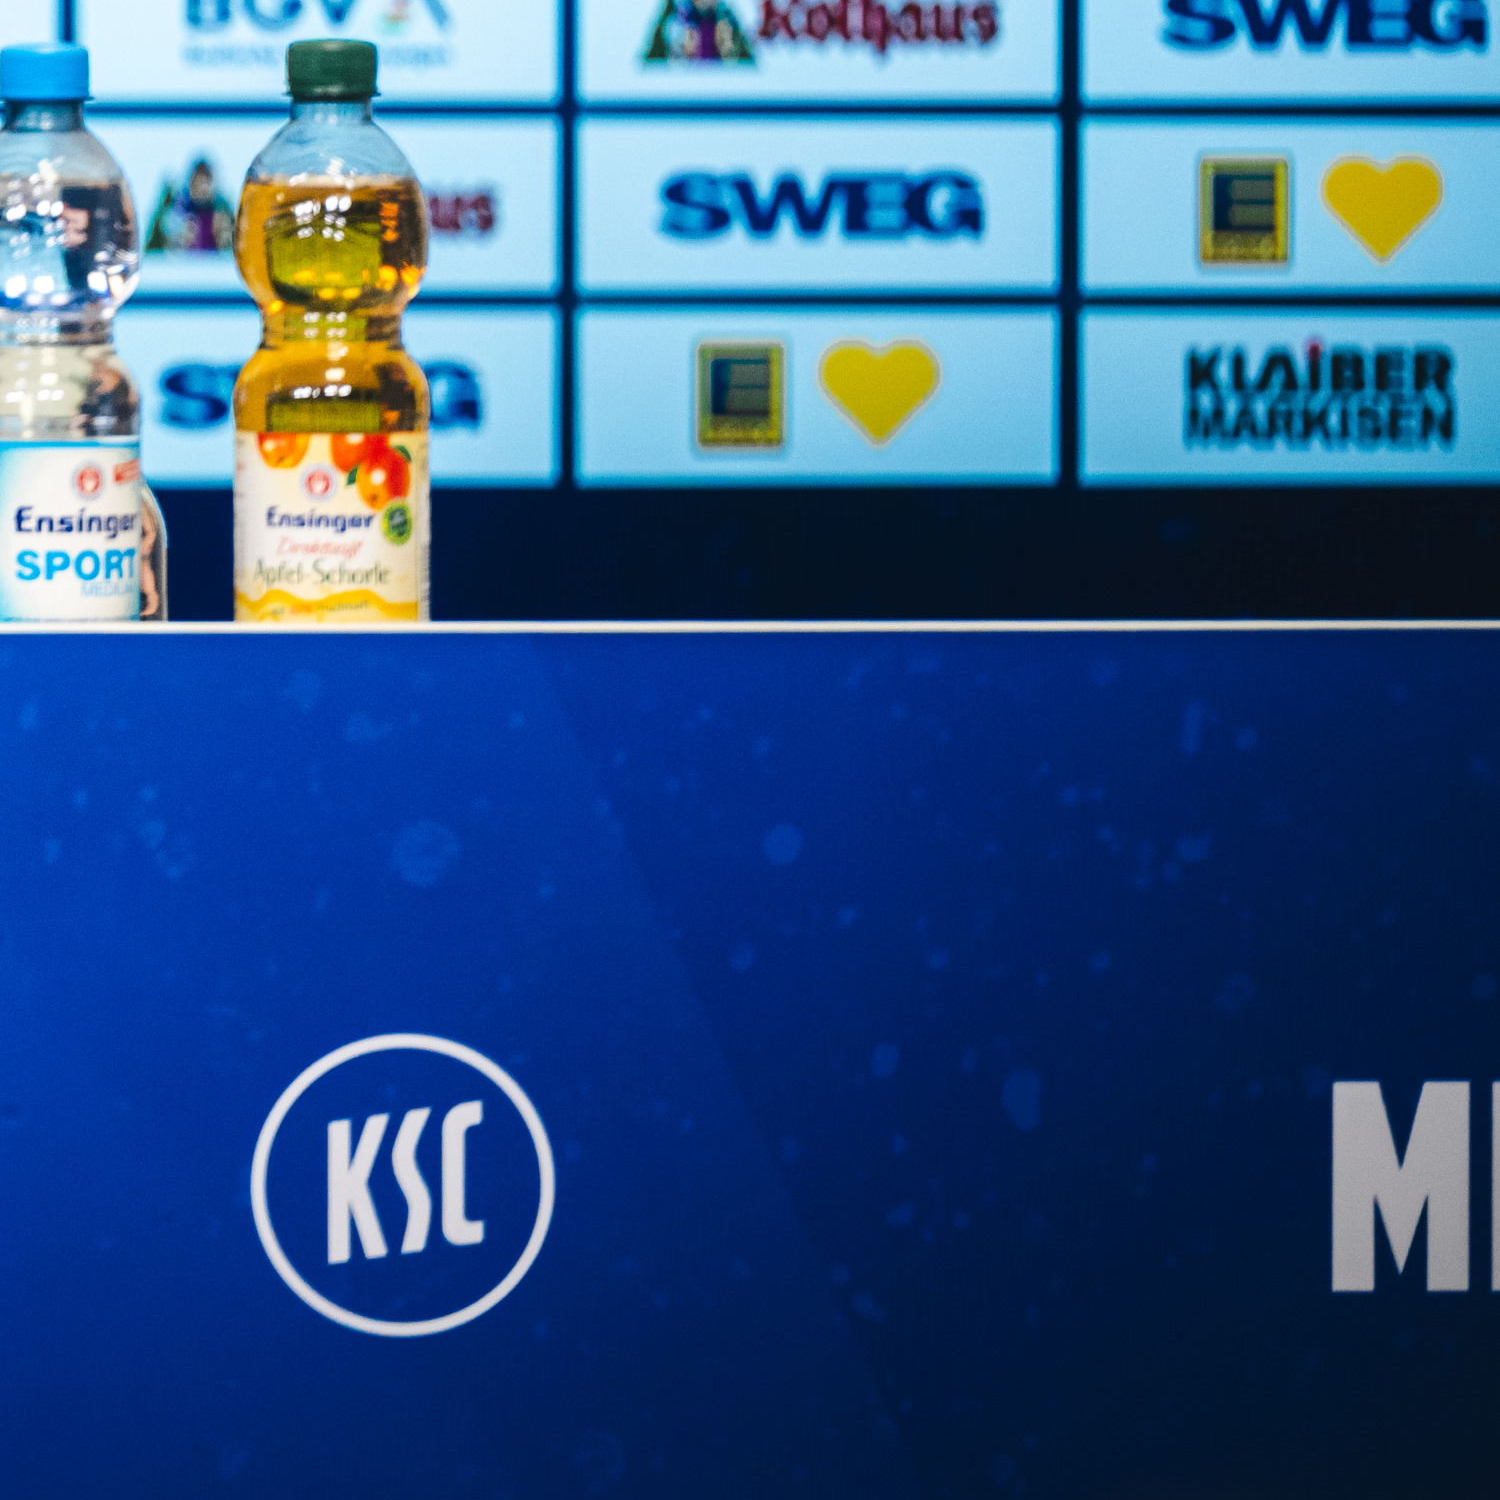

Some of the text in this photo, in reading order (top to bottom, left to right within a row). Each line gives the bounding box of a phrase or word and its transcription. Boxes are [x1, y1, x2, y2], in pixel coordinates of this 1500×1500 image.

[659, 168, 984, 242] SWEG
[15, 505, 138, 539] Ensinger
[266, 505, 377, 533] Ensinger
[15, 549, 136, 581] SPORT
[327, 1099, 485, 1266] KSC
[1332, 1080, 1500, 1292] M
